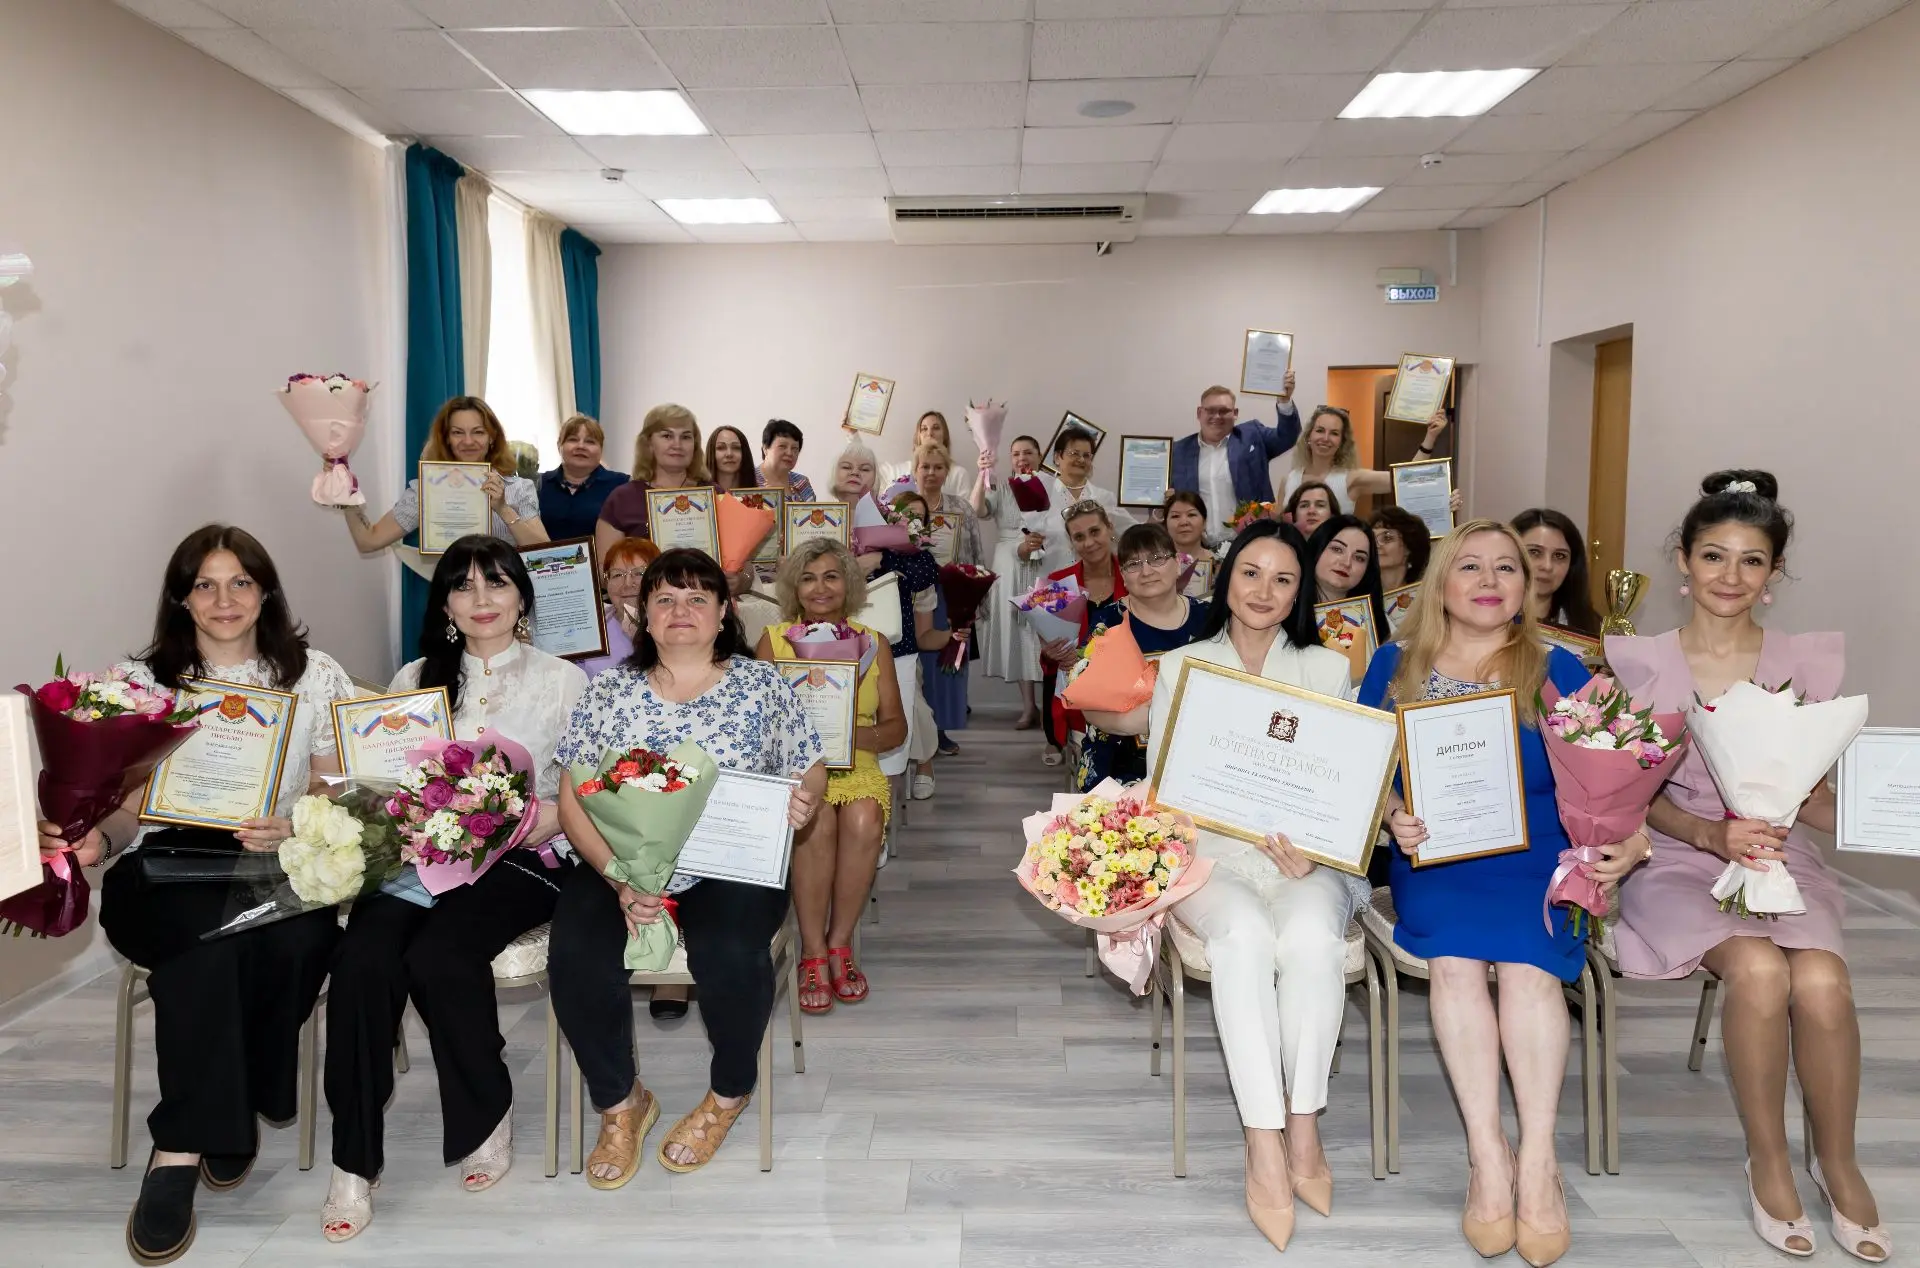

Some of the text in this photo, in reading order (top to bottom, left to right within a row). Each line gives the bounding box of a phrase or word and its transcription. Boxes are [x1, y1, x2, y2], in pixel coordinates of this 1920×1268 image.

[1390, 288, 1434, 300] ВЫХОД
[200, 723, 265, 739] АГОДАРСТВЕННОЕ
[1436, 740, 1486, 757] ДИПЛОМ
[1279, 754, 1341, 784] ГРАМОТА
